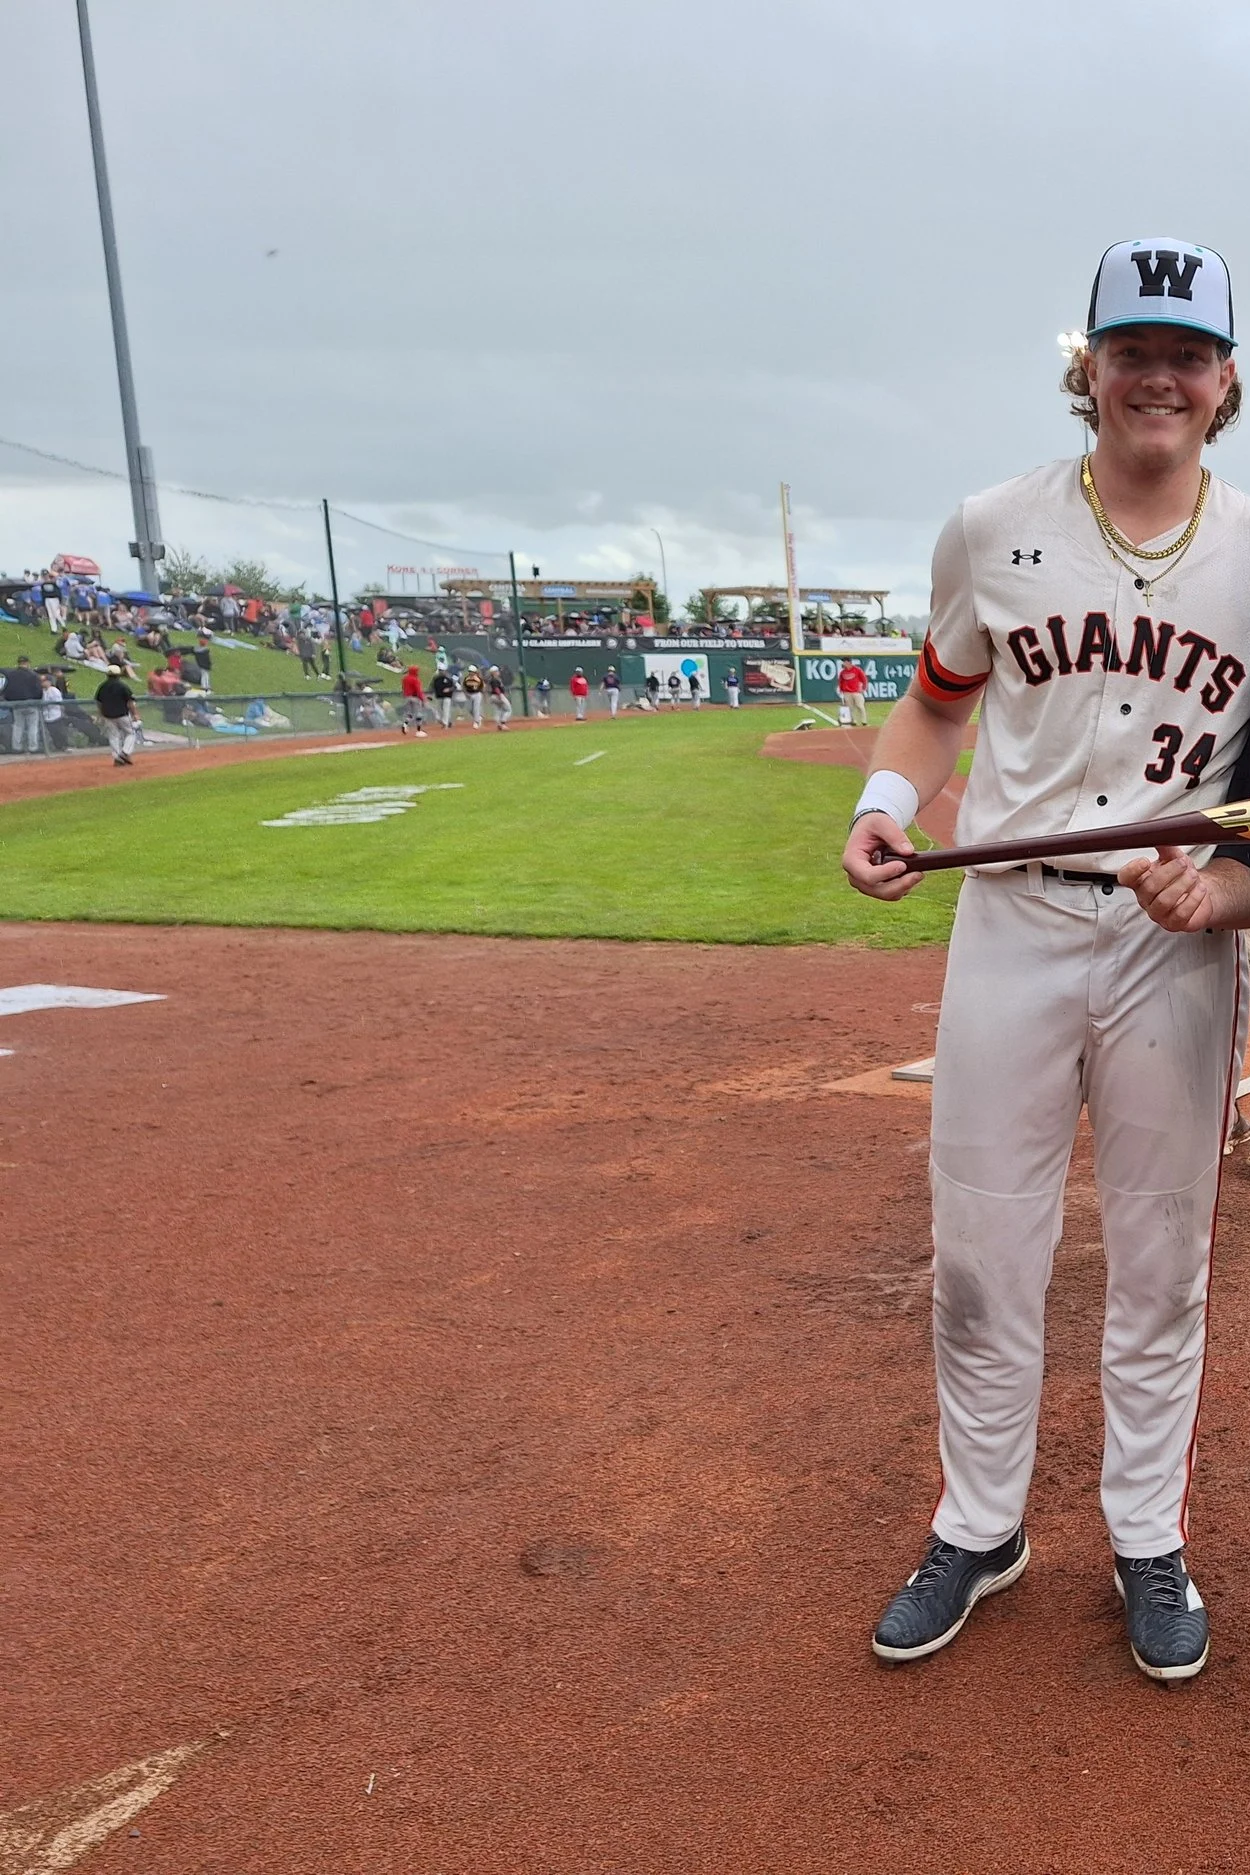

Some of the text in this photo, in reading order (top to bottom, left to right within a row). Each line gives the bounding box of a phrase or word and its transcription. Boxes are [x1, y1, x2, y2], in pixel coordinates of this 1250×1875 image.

[1131, 250, 1203, 301] W
[654, 639, 766, 648] FROM OUR FIELD TO YOURS
[1006, 612, 1247, 714] GIANTS
[864, 660, 878, 680] 4
[1144, 723, 1217, 790] 34
